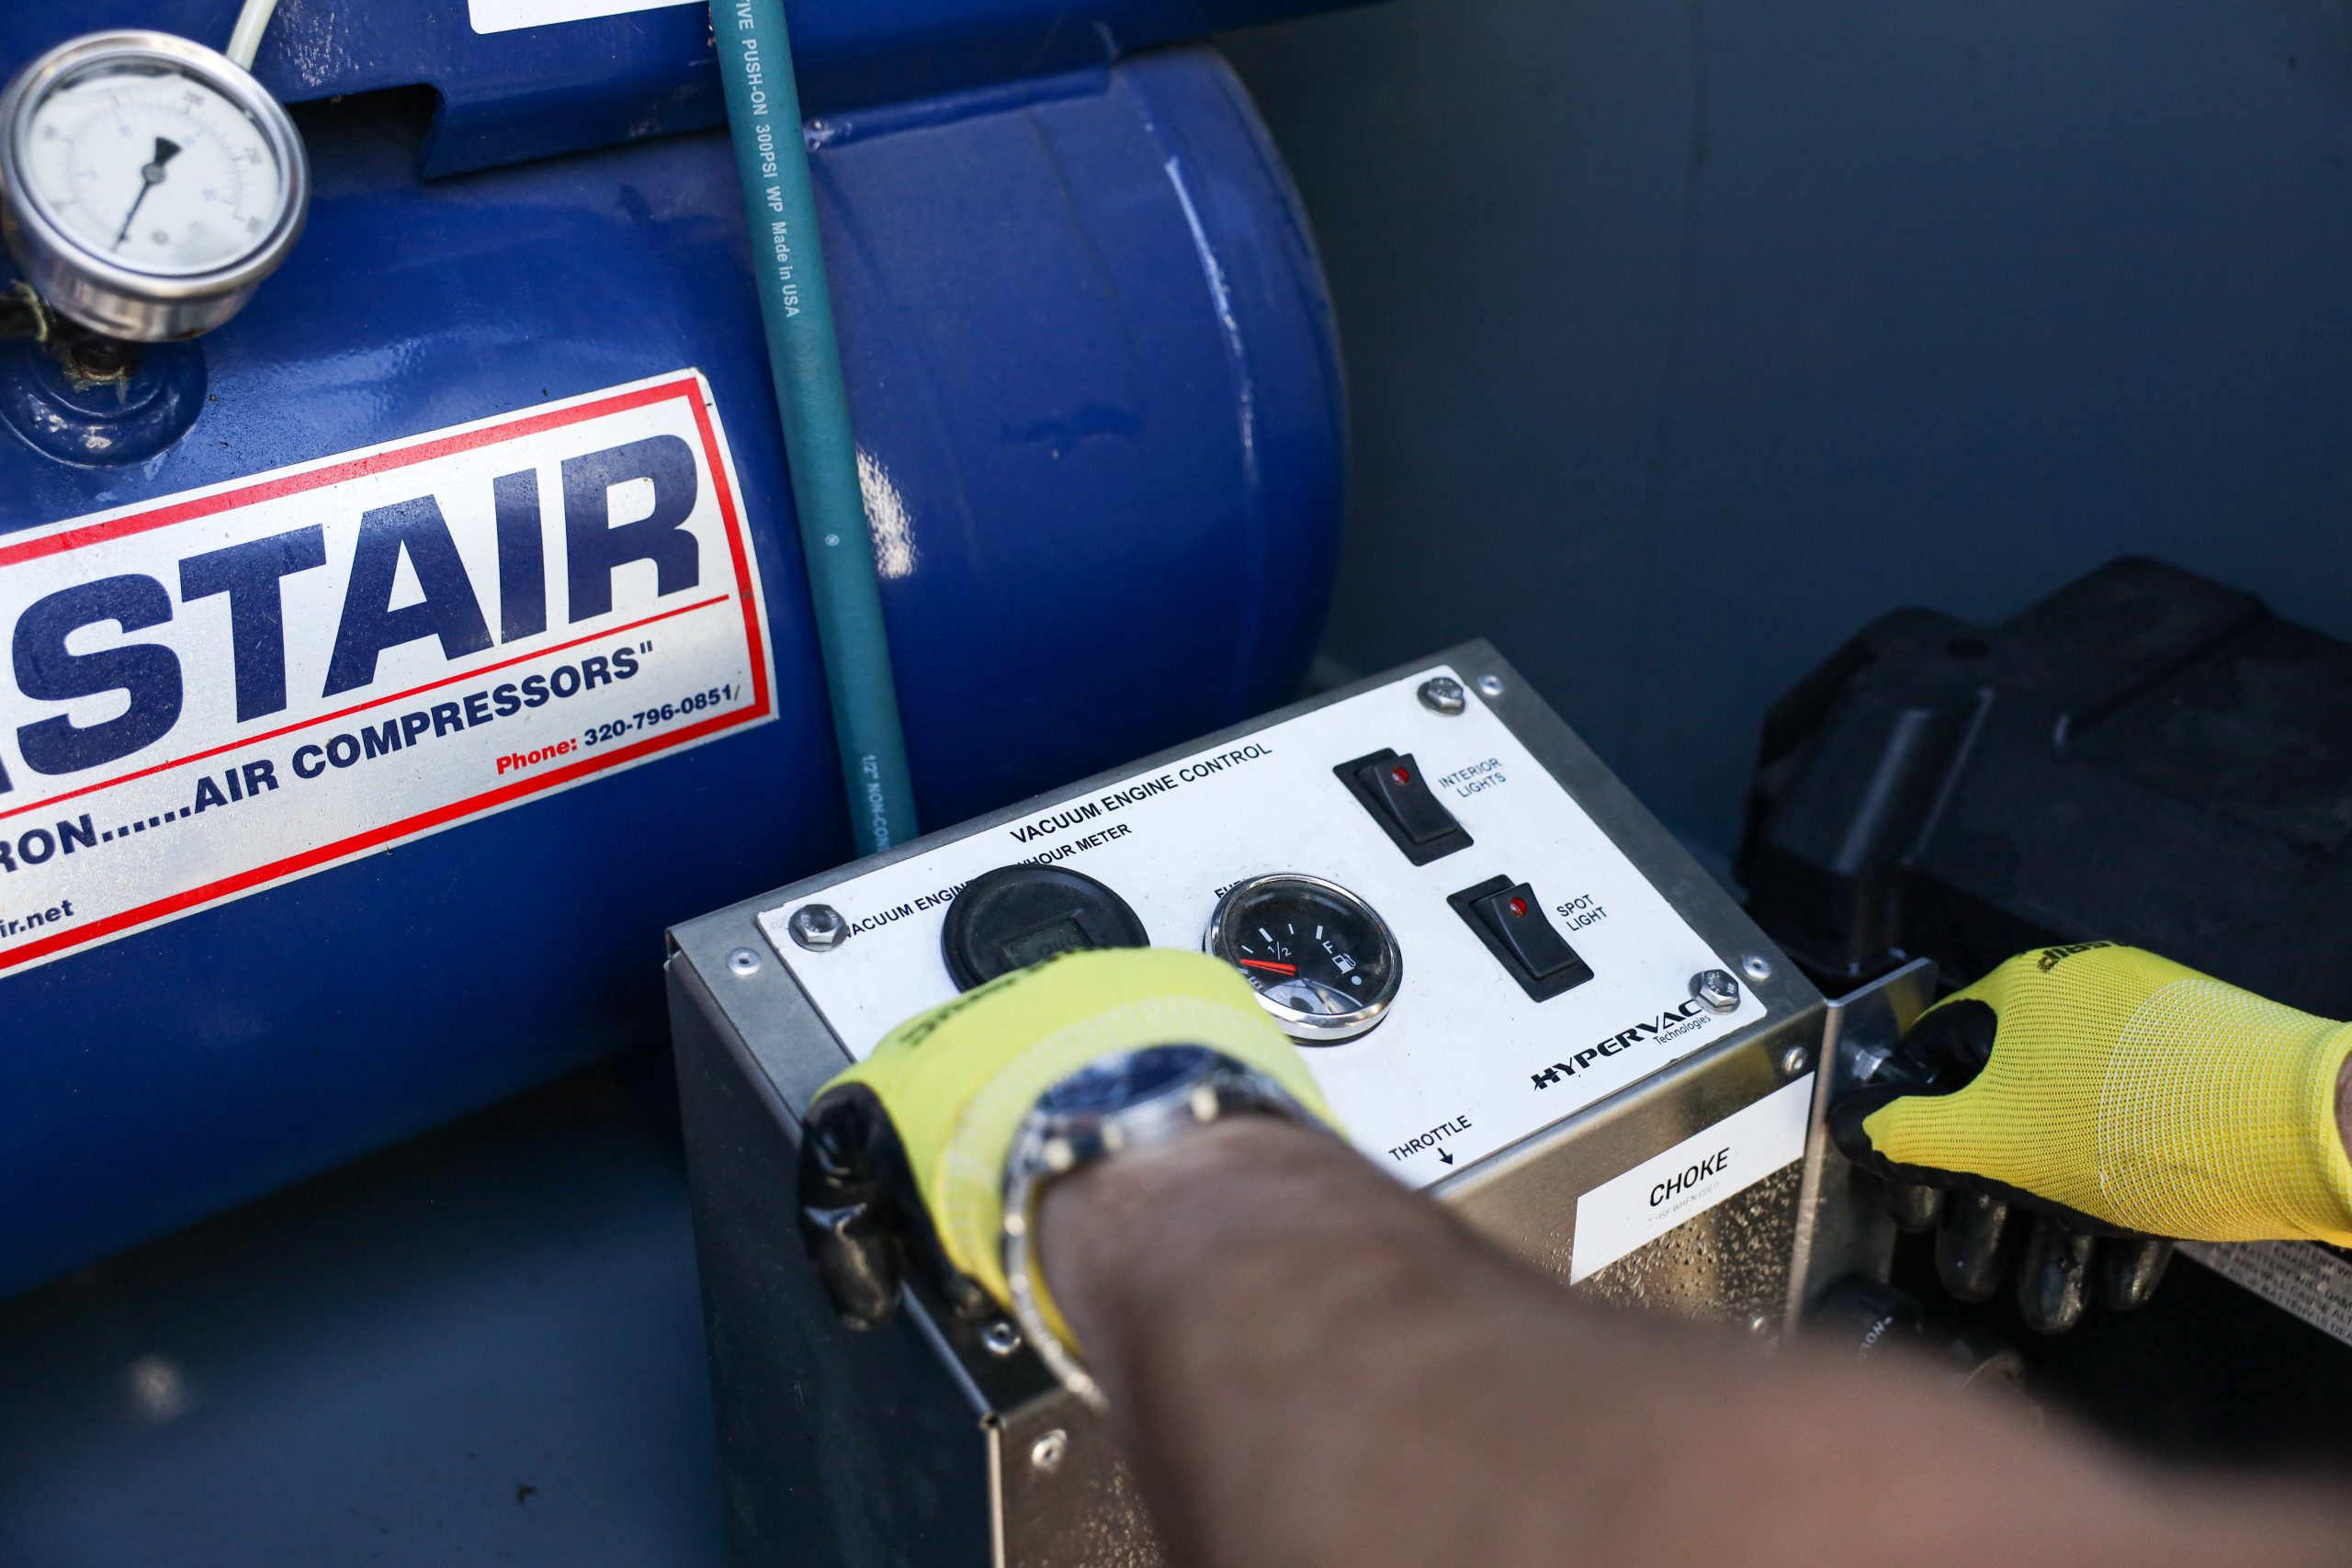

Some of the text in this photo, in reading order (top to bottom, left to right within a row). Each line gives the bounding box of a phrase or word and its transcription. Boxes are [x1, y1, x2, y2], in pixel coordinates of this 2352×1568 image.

[735, 0, 800, 318] IVE PUSH-ON 300PSI WP Made in USA
[0, 434, 700, 795] STAIR
[496, 738, 577, 774] Phone:
[1438, 758, 1502, 788] INTERIOR
[1456, 773, 1507, 797] LIGHTS
[1010, 742, 1272, 843] VACUUM ENGINE CONTROL
[1075, 824, 1132, 852] METER
[1556, 894, 1595, 918] SPOT
[1566, 907, 1608, 931] LIGHT
[1322, 940, 1334, 954] F
[1531, 998, 1703, 1091] HYPERVAC
[1653, 1014, 1712, 1045] Technologies
[1388, 1114, 1473, 1161] THROTTLE
[1650, 1146, 1730, 1207] CHOKE
